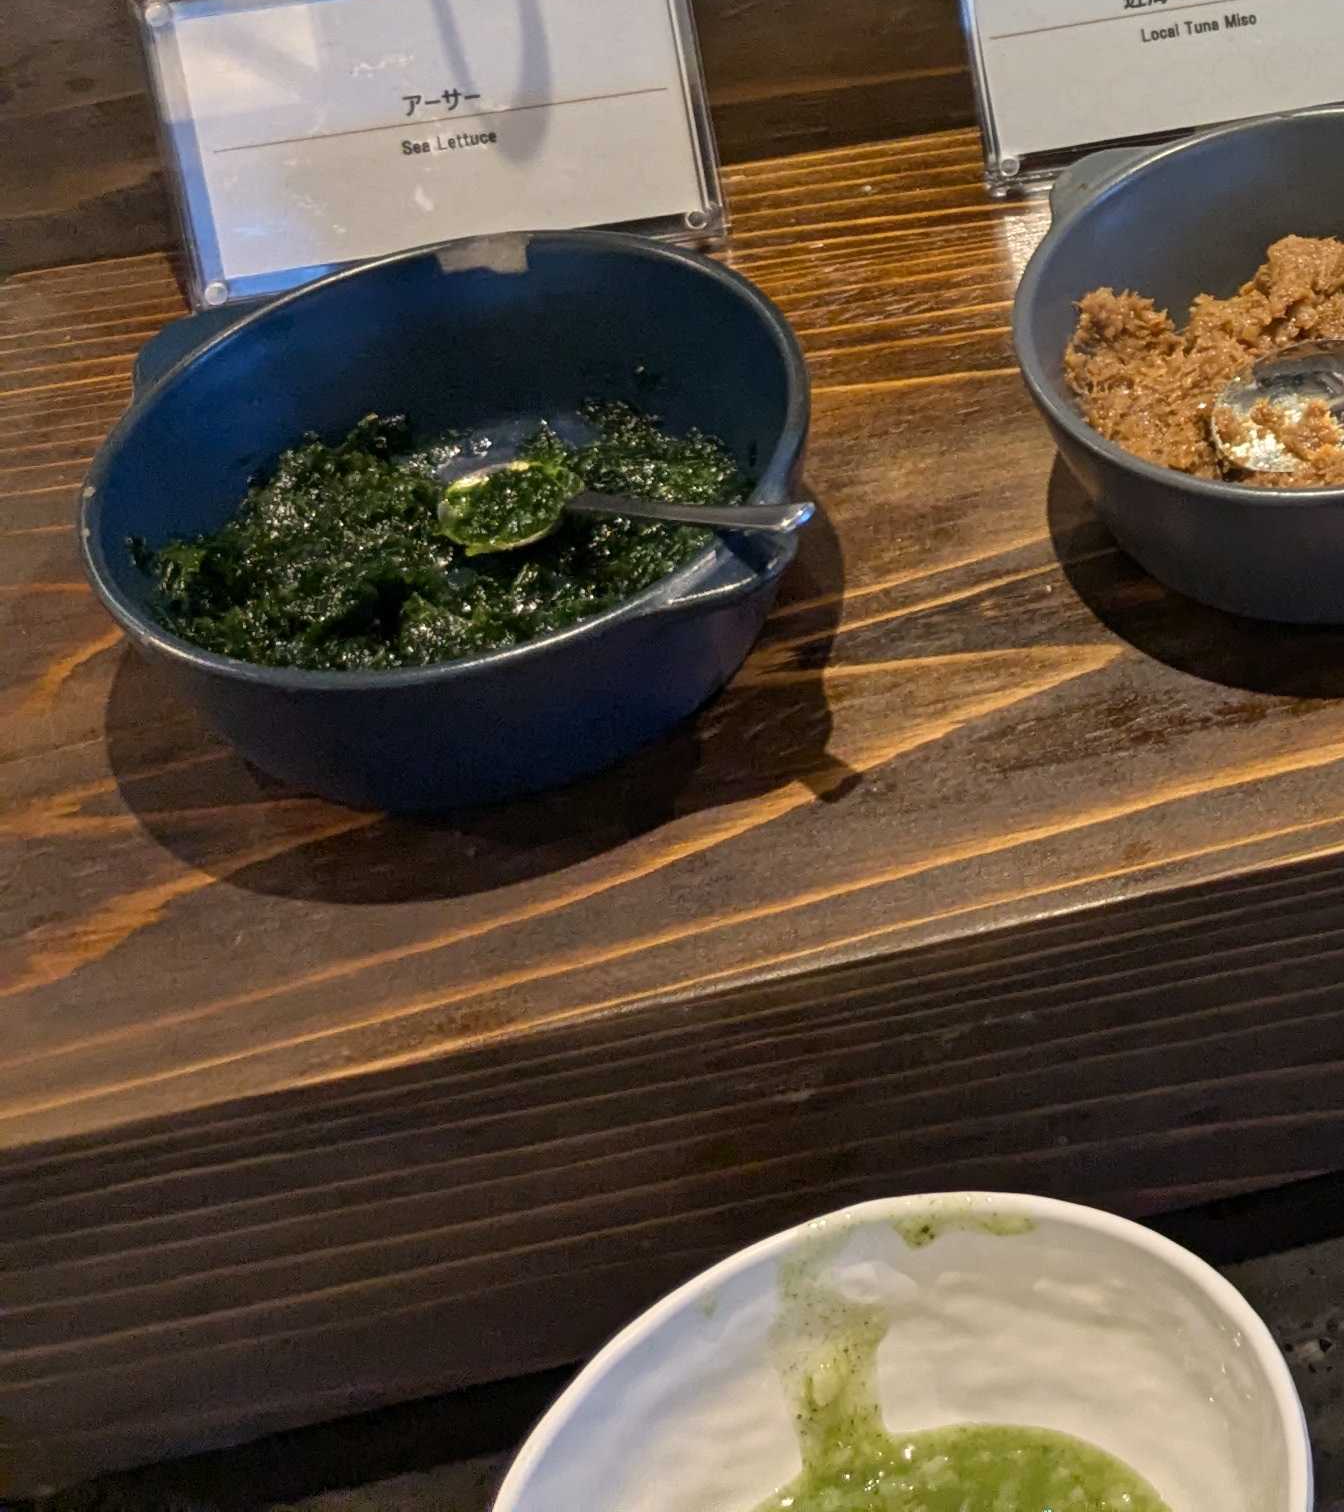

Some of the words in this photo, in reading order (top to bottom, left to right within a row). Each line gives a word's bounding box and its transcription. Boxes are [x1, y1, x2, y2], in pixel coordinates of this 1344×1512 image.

[1140, 23, 1180, 43] Local
[1184, 20, 1220, 35] Tuna
[1224, 13, 1257, 29] Miso
[402, 88, 481, 117] アーサー
[402, 140, 431, 156] Sea
[437, 132, 497, 151] Lettuce
